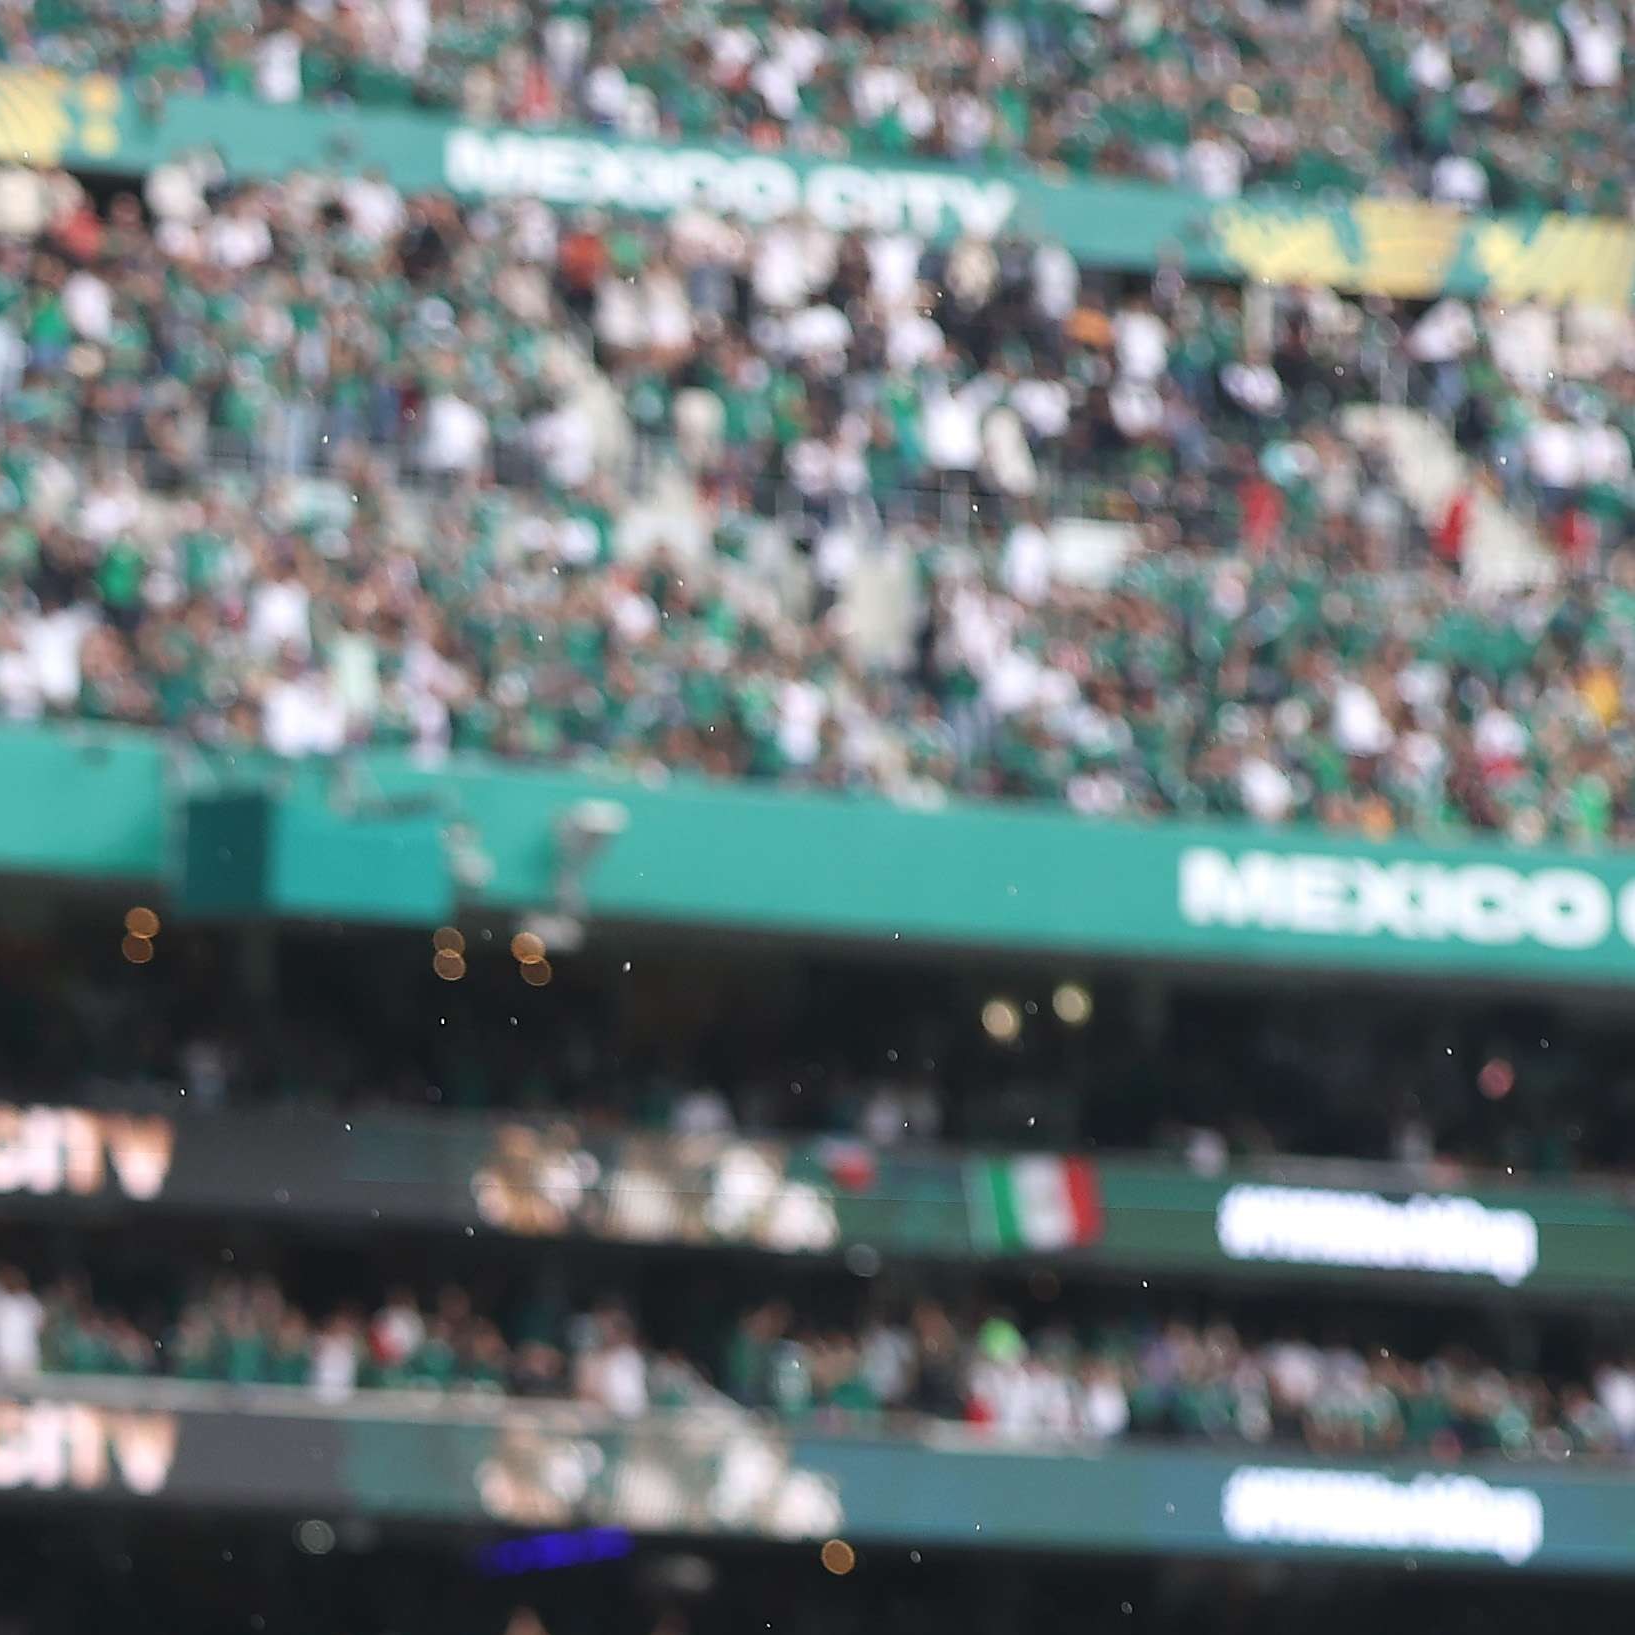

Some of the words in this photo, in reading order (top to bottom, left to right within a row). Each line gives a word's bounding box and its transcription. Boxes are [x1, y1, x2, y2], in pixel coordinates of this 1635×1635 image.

[445, 131, 799, 220] MEXICO
[806, 166, 1019, 242] CITY
[1179, 846, 1612, 949] MEXICO
